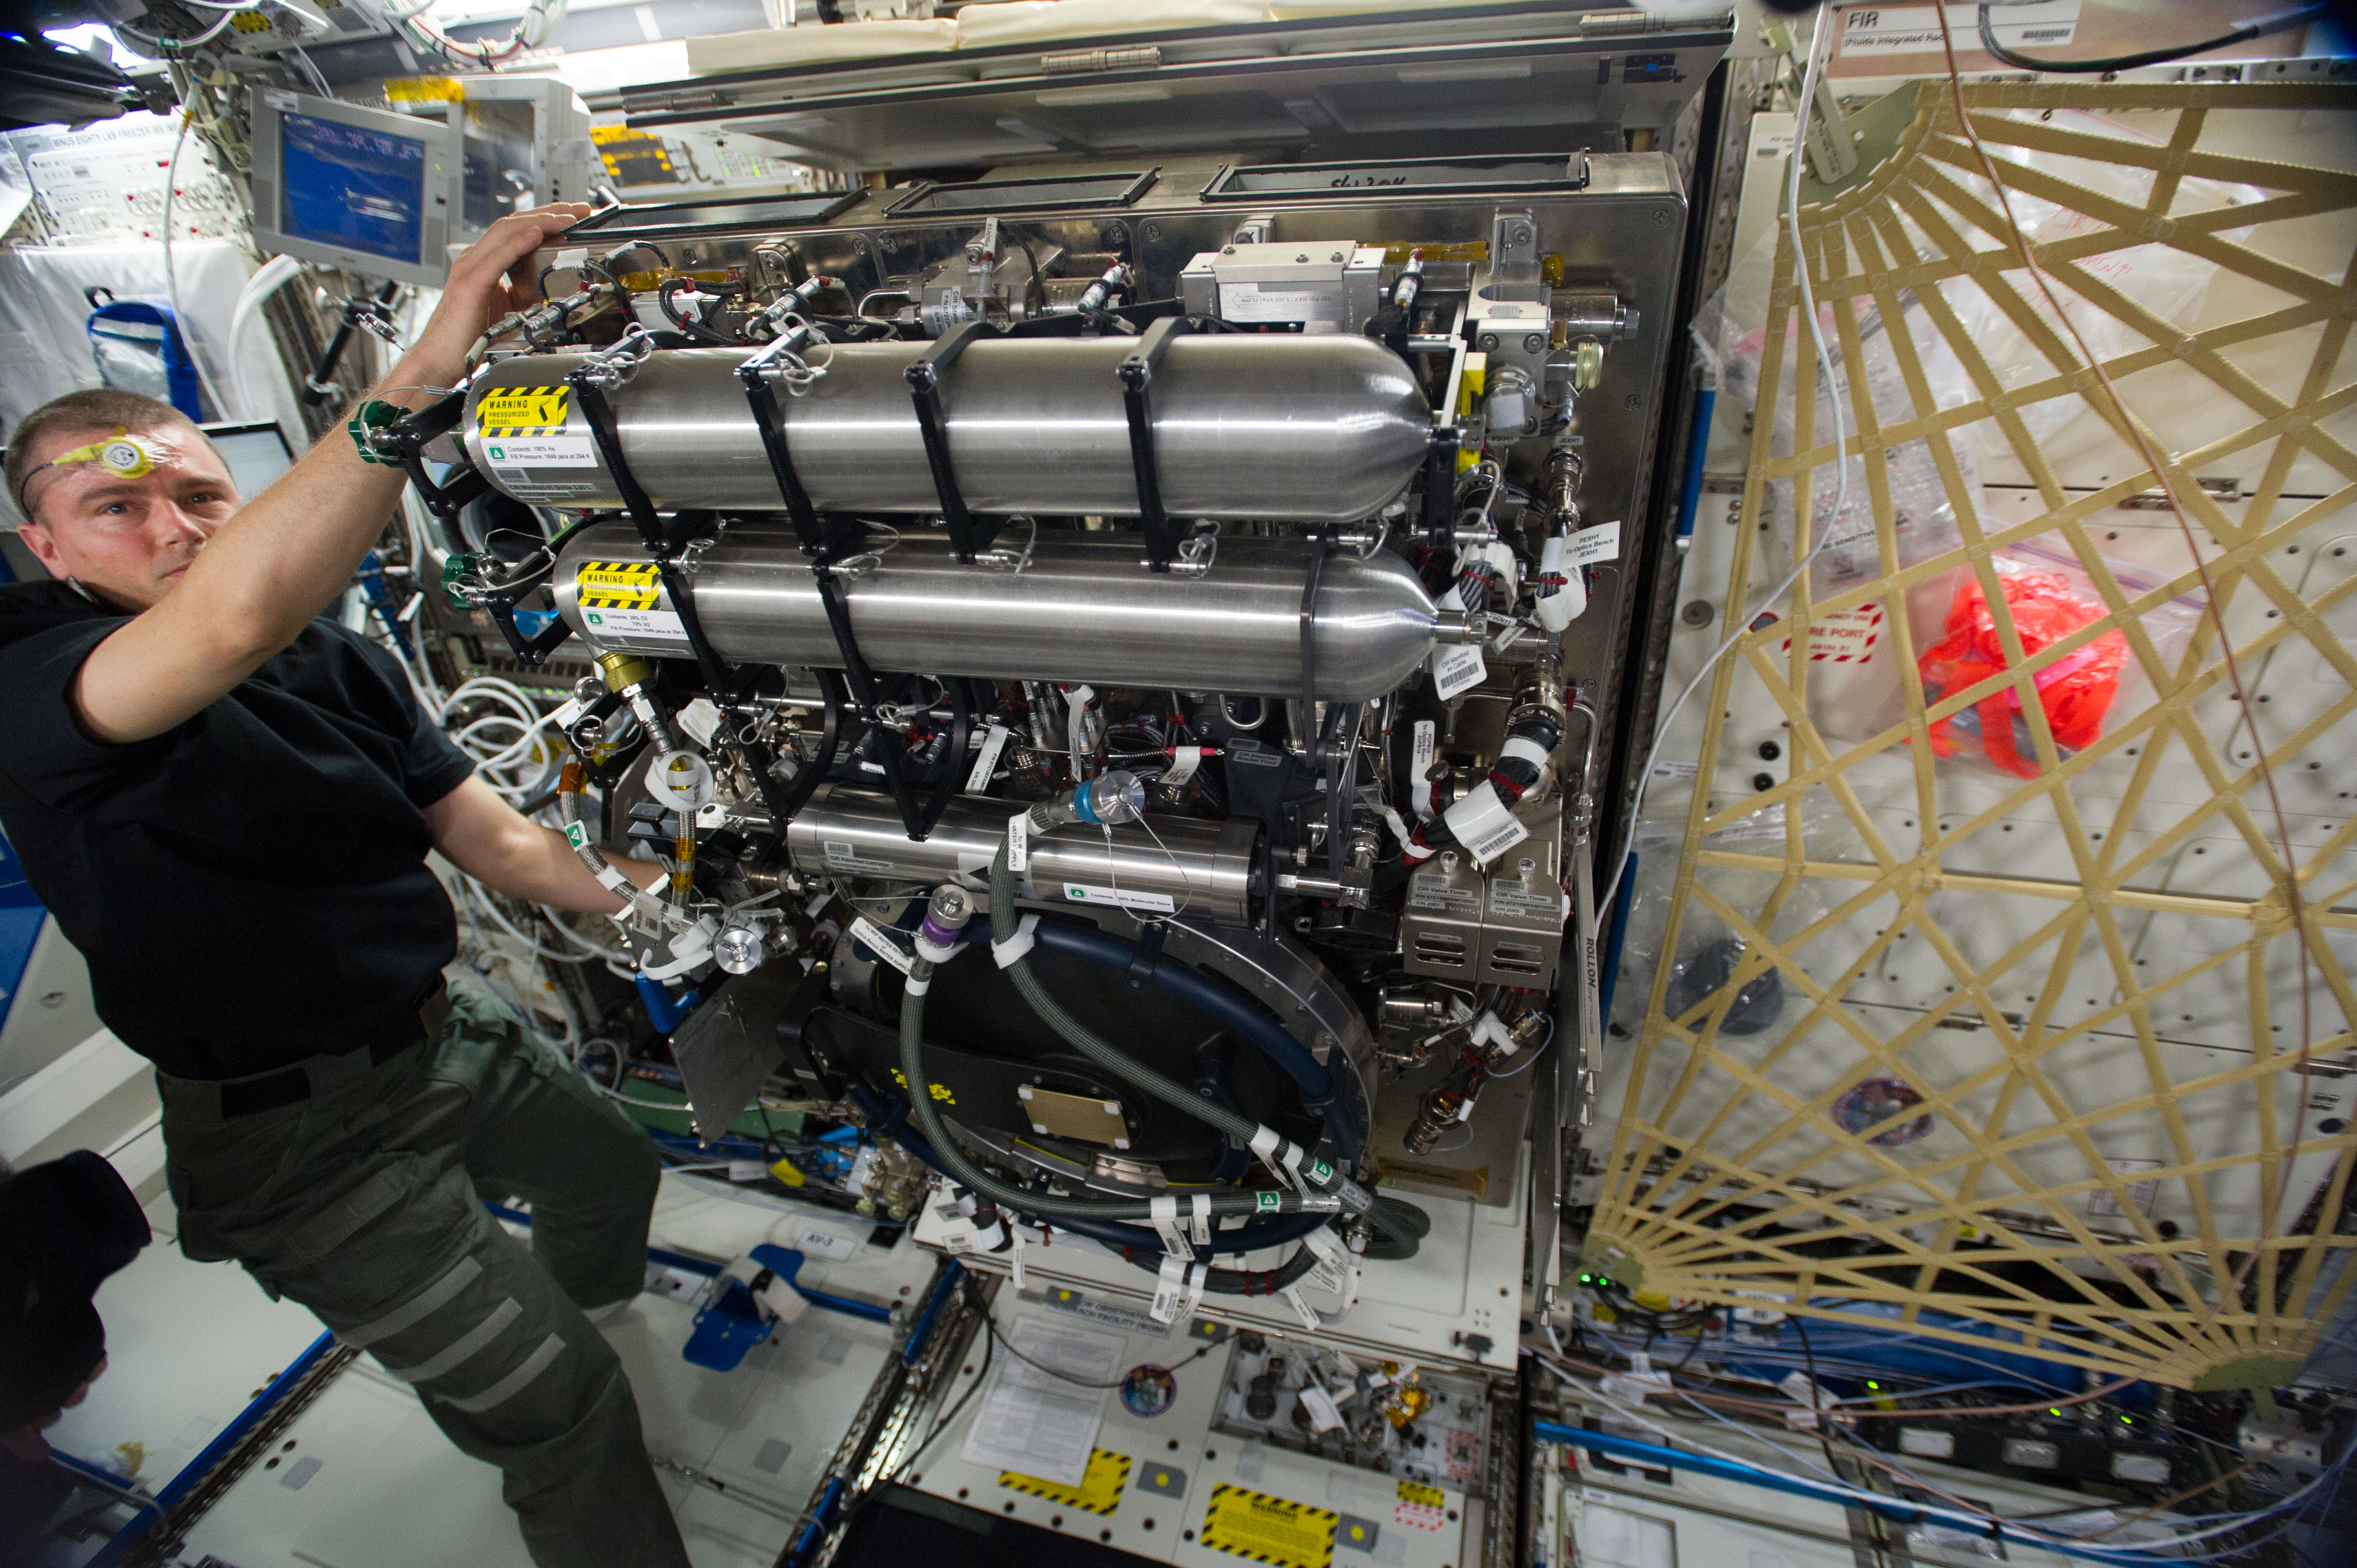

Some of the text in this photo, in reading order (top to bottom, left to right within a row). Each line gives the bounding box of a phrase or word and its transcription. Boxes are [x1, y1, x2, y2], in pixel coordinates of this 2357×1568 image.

[1848, 11, 1879, 29] FIR
[1877, 34, 1923, 45] Integrated
[1925, 33, 1945, 42] Rac
[53, 137, 75, 147] MINUS
[76, 134, 100, 145] EIGHTY
[117, 126, 151, 138] FREEZER
[489, 400, 528, 409] WARNING
[1579, 534, 1599, 544] PEXH1
[1574, 543, 1593, 553] Optics
[1593, 538, 1614, 547] Bench
[1578, 549, 1598, 558] JEXH1
[587, 574, 623, 583] WARNING
[1489, 613, 1511, 625] PSOV11
[1830, 629, 1866, 637] PORT
[1442, 649, 1470, 669] CIR Manifold
[1453, 659, 1467, 669] Cable
[854, 928, 910, 973] Optics Bench WATER SUPPLY
[878, 935, 892, 948] WATER
[892, 946, 910, 962] RETURN
[1586, 937, 1597, 988] ROLLON
